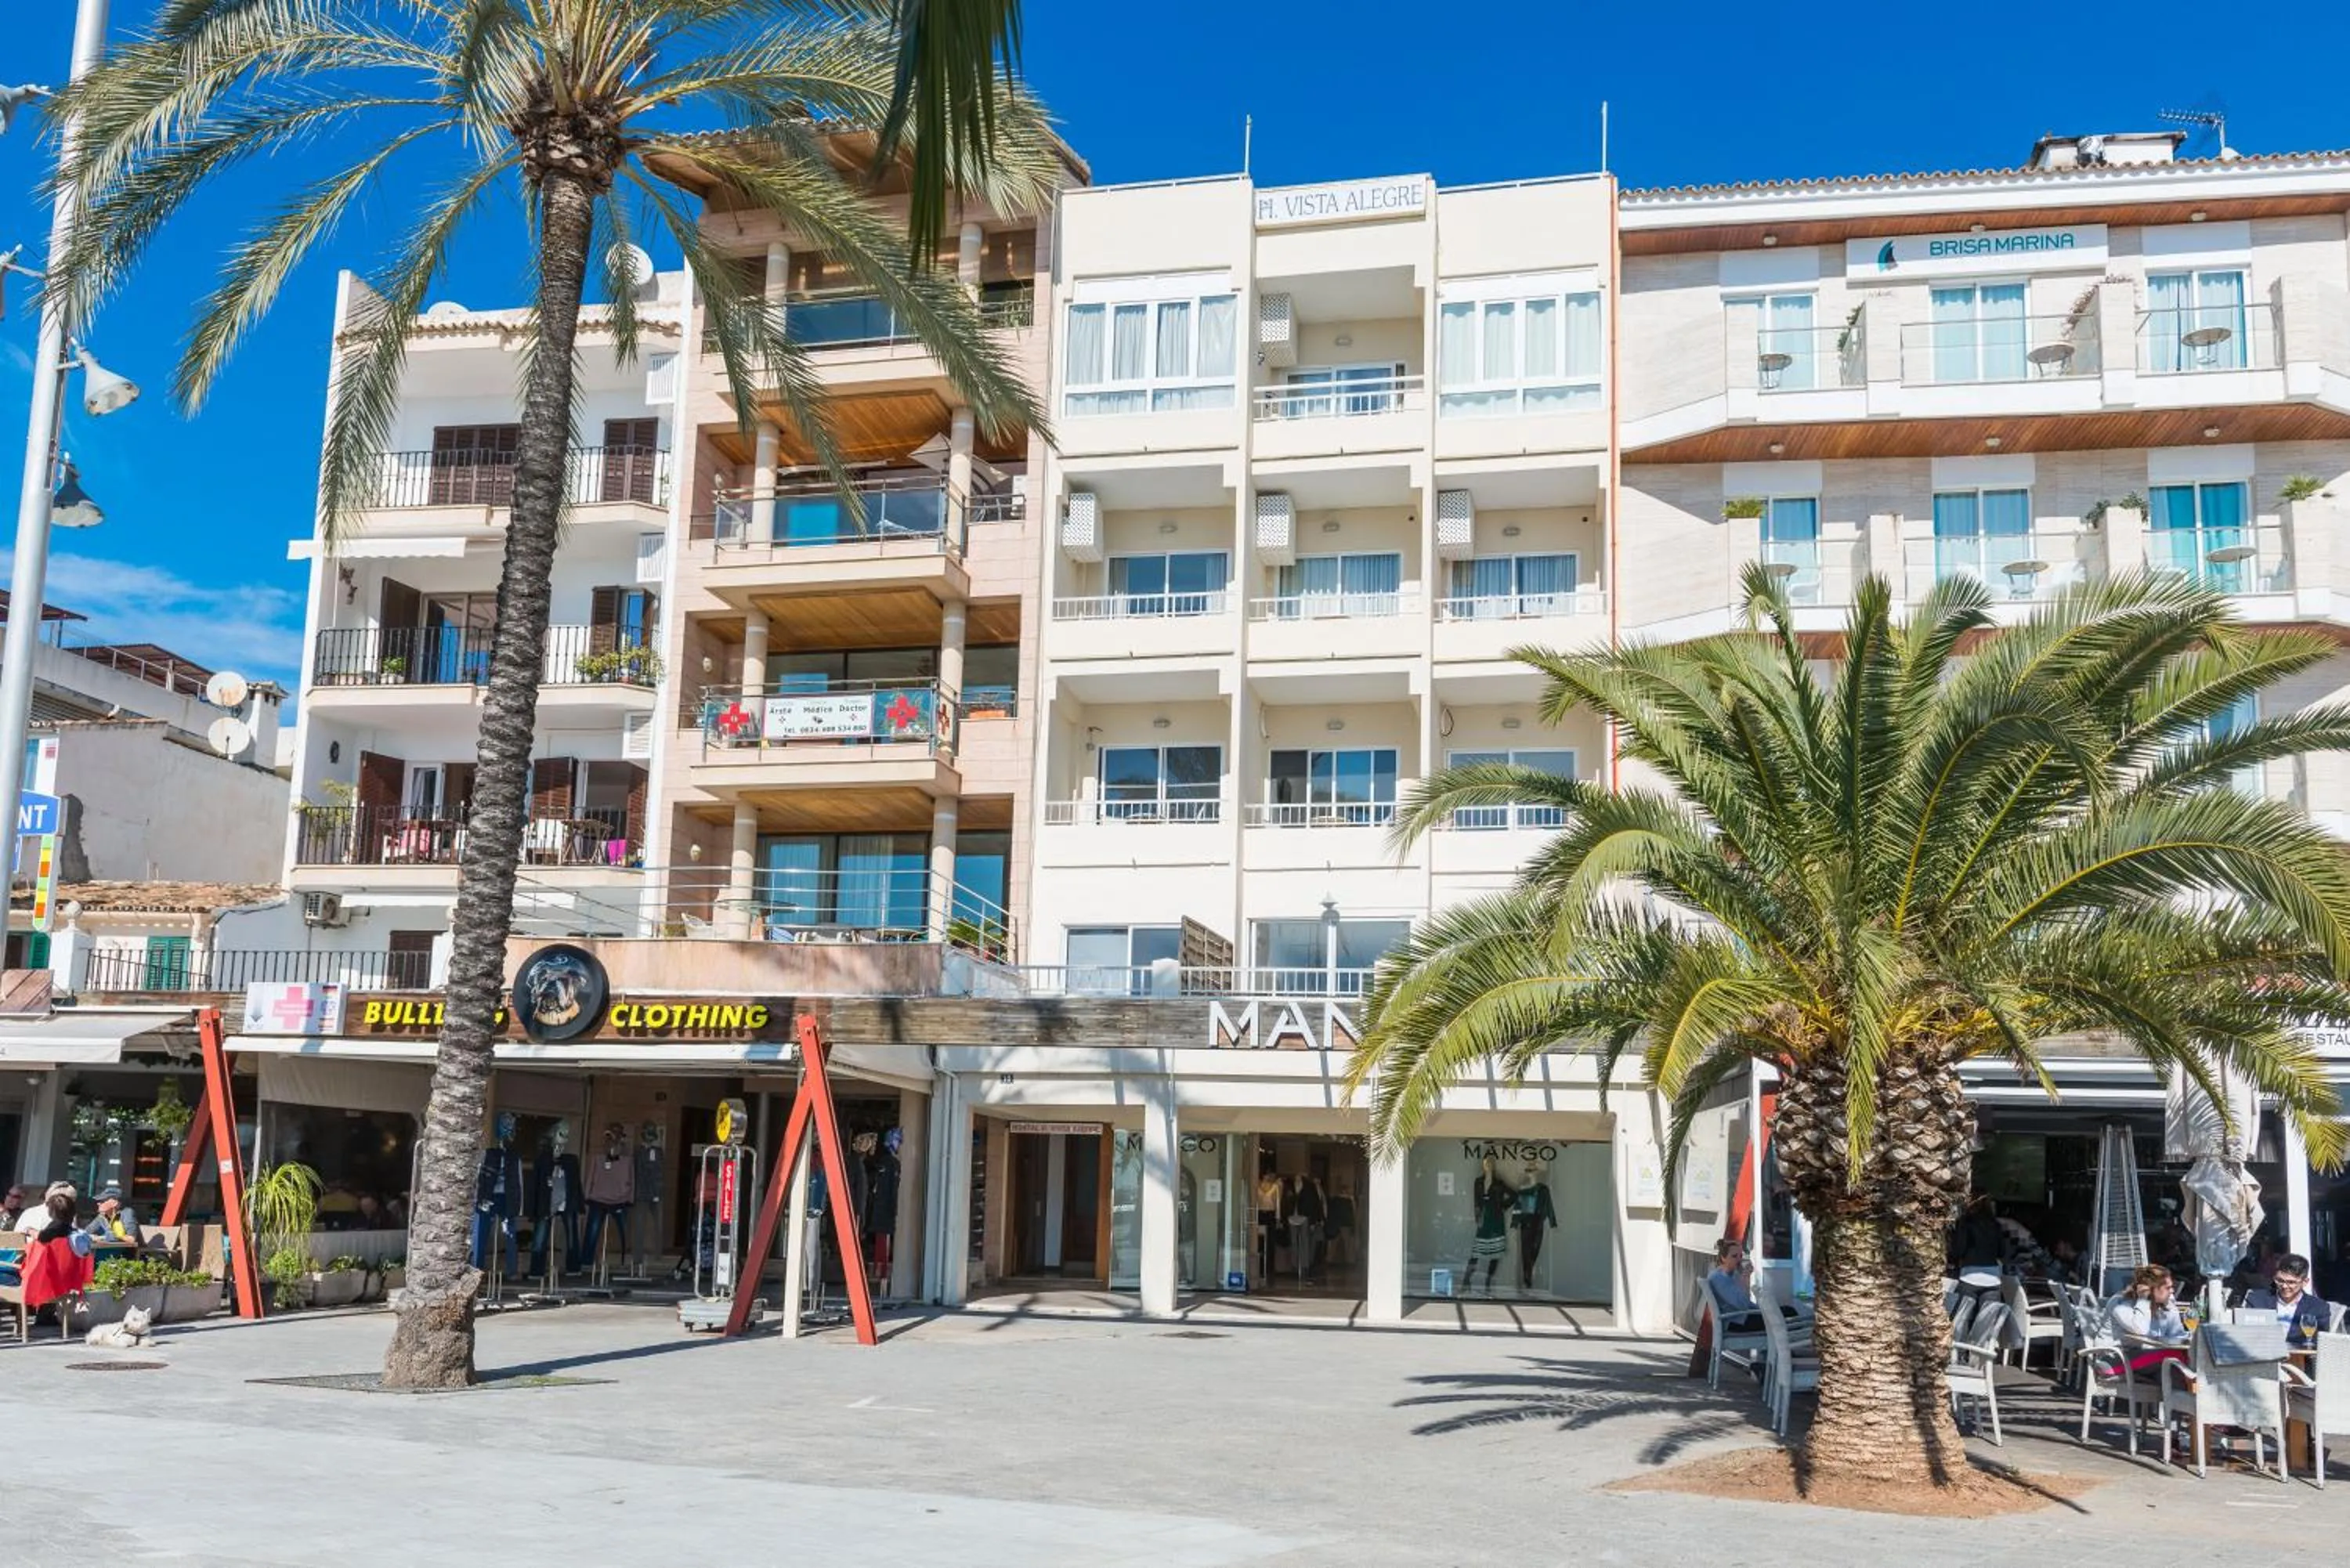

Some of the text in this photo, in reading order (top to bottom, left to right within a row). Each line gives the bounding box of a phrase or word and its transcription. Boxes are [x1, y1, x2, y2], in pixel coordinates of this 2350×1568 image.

[1285, 192, 1339, 217] VISTA
[1345, 183, 1423, 213] ALEGRE
[1929, 233, 2073, 257] BRISA MARINA
[610, 1003, 768, 1028] CLOTHING
[1209, 1000, 1363, 1050] MAN
[1127, 1136, 1216, 1153] MGO
[1464, 1144, 1557, 1161] MANGO
[723, 1164, 732, 1220] SALE
